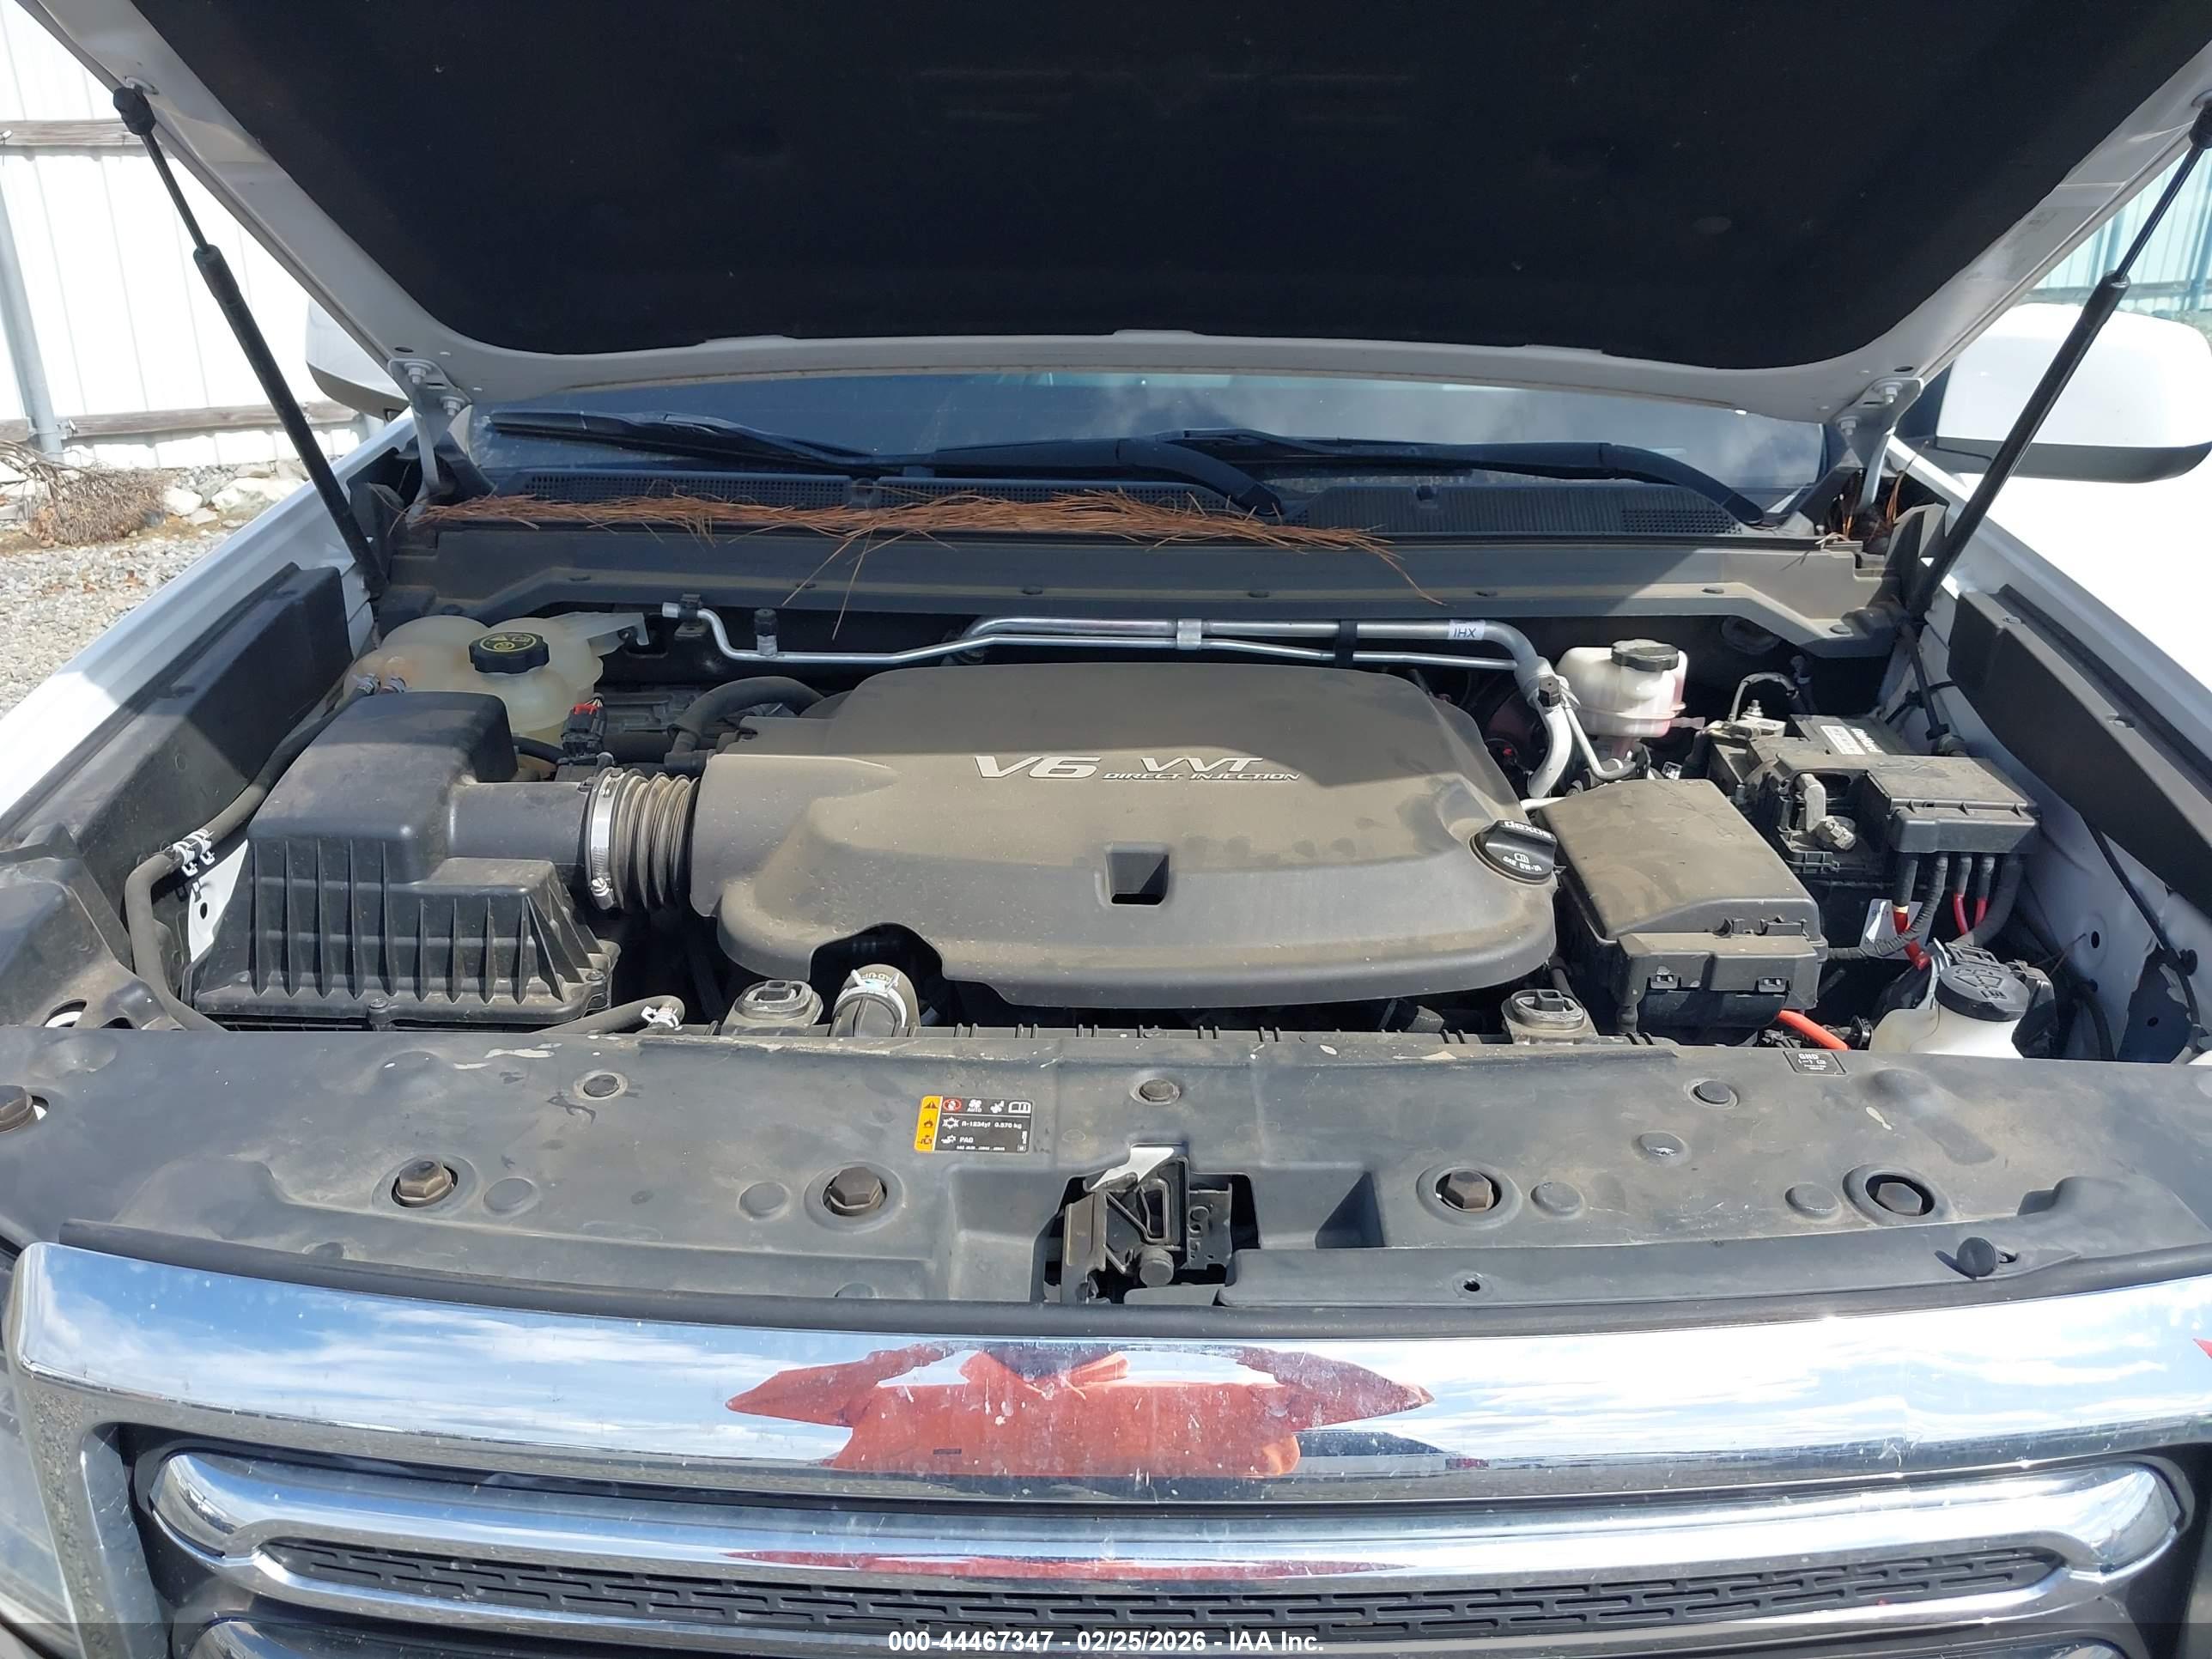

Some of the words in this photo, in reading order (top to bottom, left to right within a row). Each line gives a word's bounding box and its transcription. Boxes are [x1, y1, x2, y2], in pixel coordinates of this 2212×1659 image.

[975, 756, 1101, 779] V6
[1140, 757, 1263, 773] VVT
[1102, 772, 1183, 781] DIRECT
[1188, 772, 1301, 781] INJECTION
